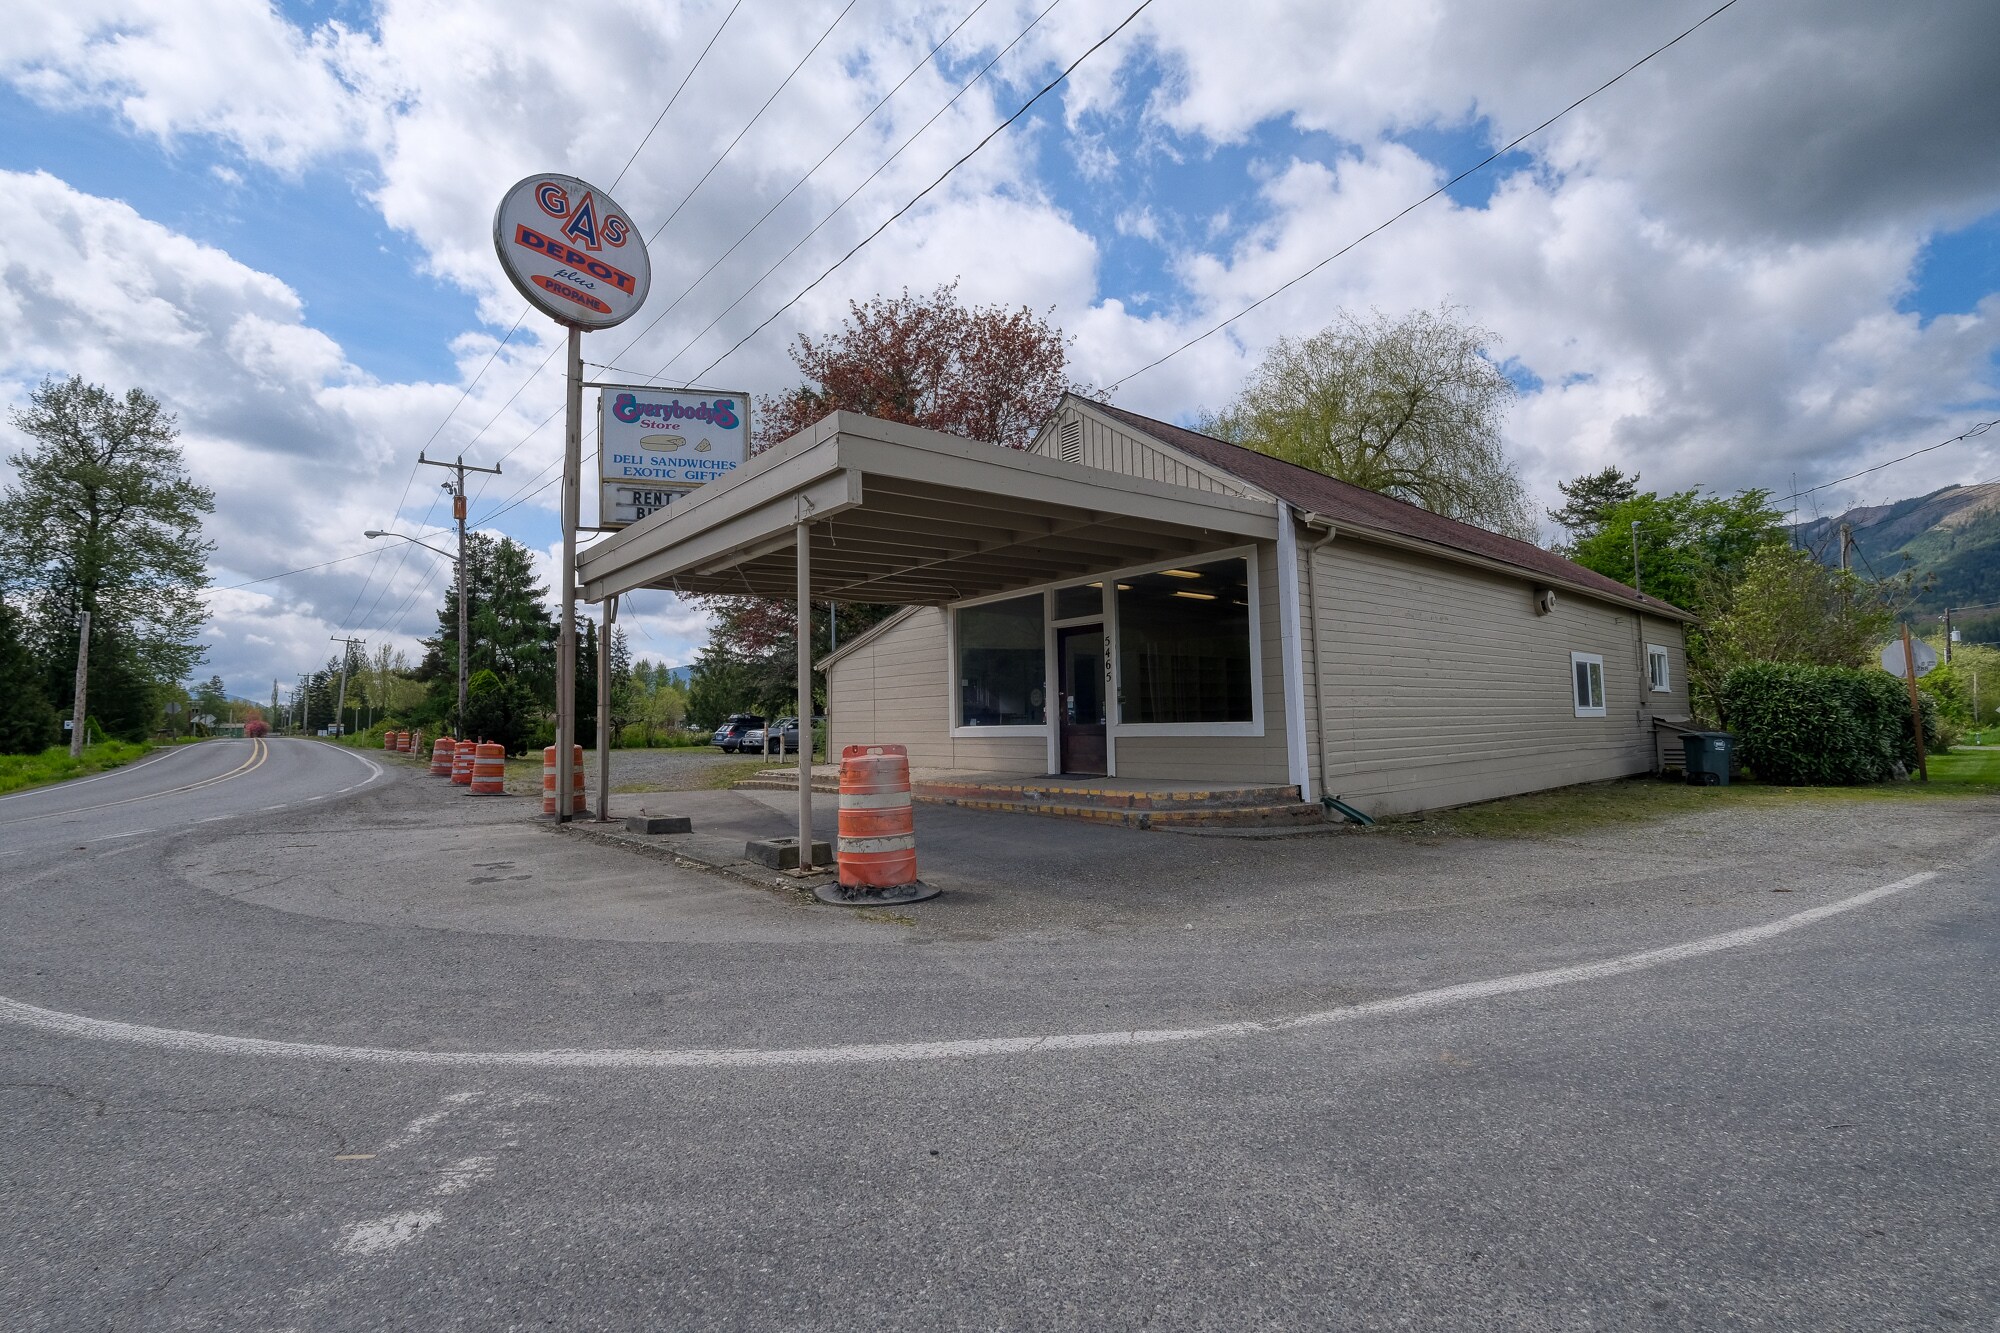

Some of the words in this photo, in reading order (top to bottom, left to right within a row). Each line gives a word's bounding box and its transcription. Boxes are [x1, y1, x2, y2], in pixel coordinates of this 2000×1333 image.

[536, 183, 629, 250] GAS
[521, 229, 630, 288] DEPOT
[553, 269, 596, 290] plus
[545, 279, 601, 310] PROPANE
[639, 419, 681, 431] Store
[613, 454, 643, 465] DELI
[650, 456, 737, 471] SANDWICHES
[623, 466, 677, 479] EXOTIC
[633, 491, 672, 505] RENT
